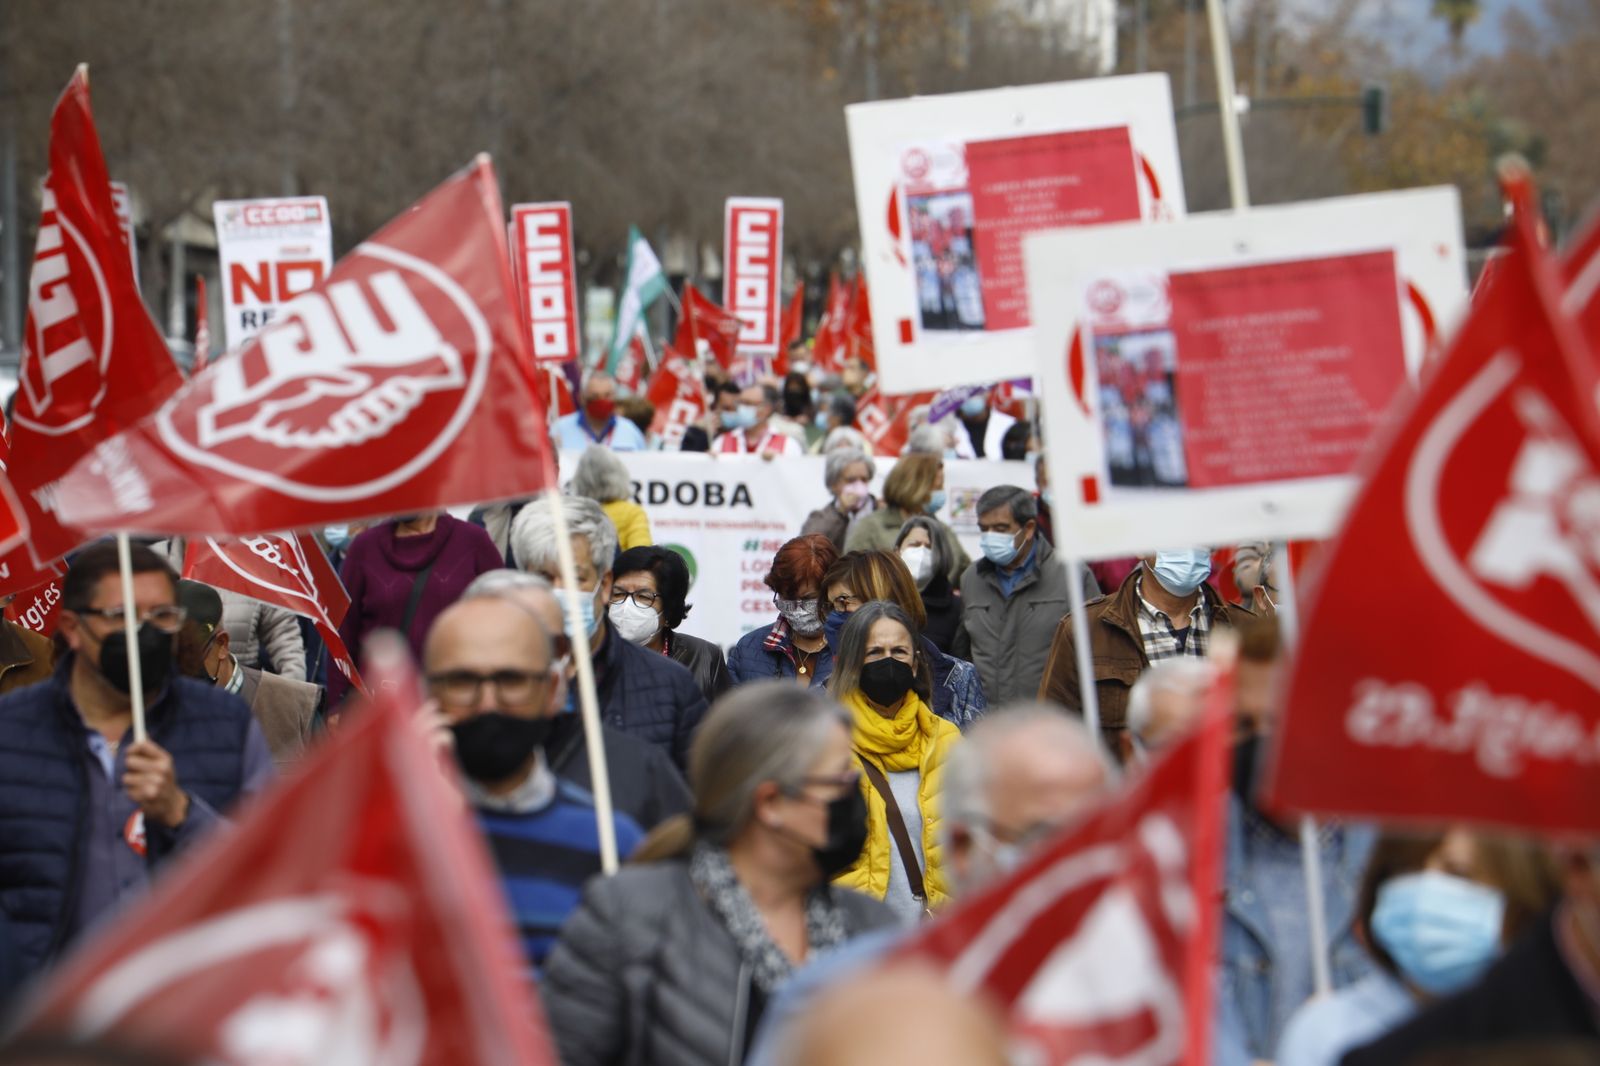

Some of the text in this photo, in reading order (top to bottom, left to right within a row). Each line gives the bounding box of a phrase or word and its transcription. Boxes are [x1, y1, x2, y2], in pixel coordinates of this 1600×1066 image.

[230, 261, 323, 304] NO
[523, 212, 569, 356] CCOO
[736, 211, 771, 341] CCOO
